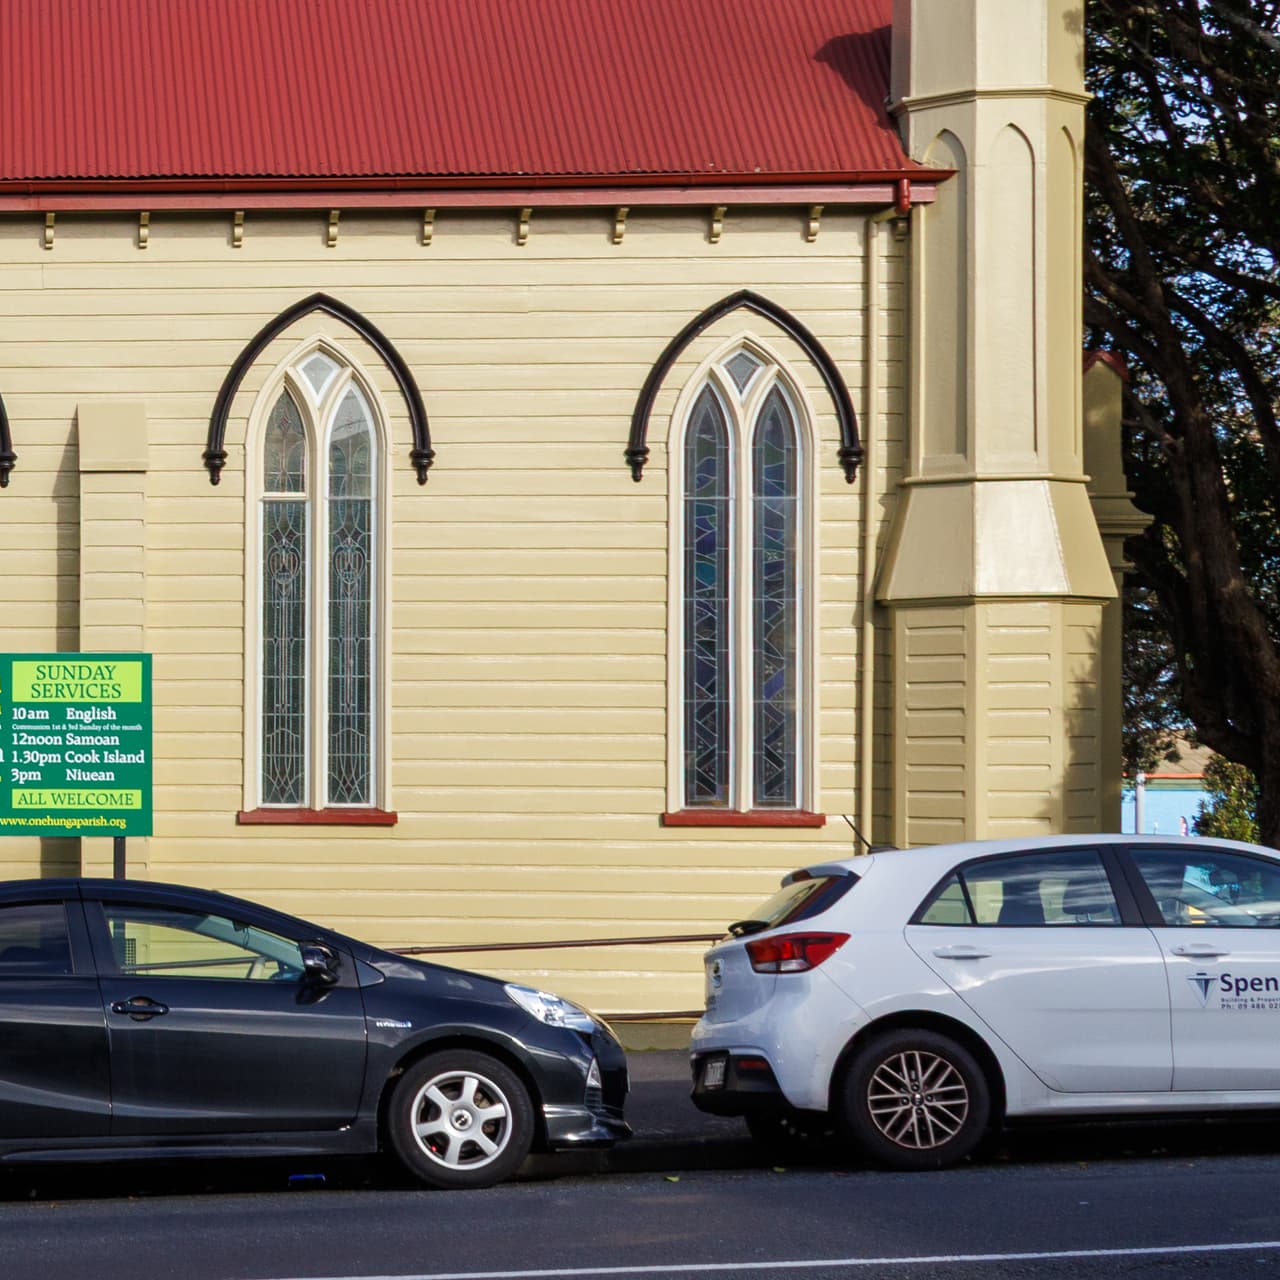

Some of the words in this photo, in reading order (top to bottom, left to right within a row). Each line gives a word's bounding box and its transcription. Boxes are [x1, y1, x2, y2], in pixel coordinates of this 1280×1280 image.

[36, 665, 116, 680] SUNDAY
[31, 683, 122, 699] SERVICES
[66, 706, 116, 723] English
[79, 724, 102, 732] Sunday
[12, 733, 62, 746] 12noon
[65, 733, 120, 746] Samoan
[12, 750, 61, 766] 1.30pm
[64, 750, 100, 764] Cook
[104, 750, 145, 764] Island
[11, 768, 42, 784] 3pm
[66, 768, 115, 781] Niuean
[18, 793, 47, 805] ALL
[51, 793, 134, 806] WELCOME
[0, 816, 126, 829] www.onehungaparish.org
[1220, 974, 1279, 996] Spen
